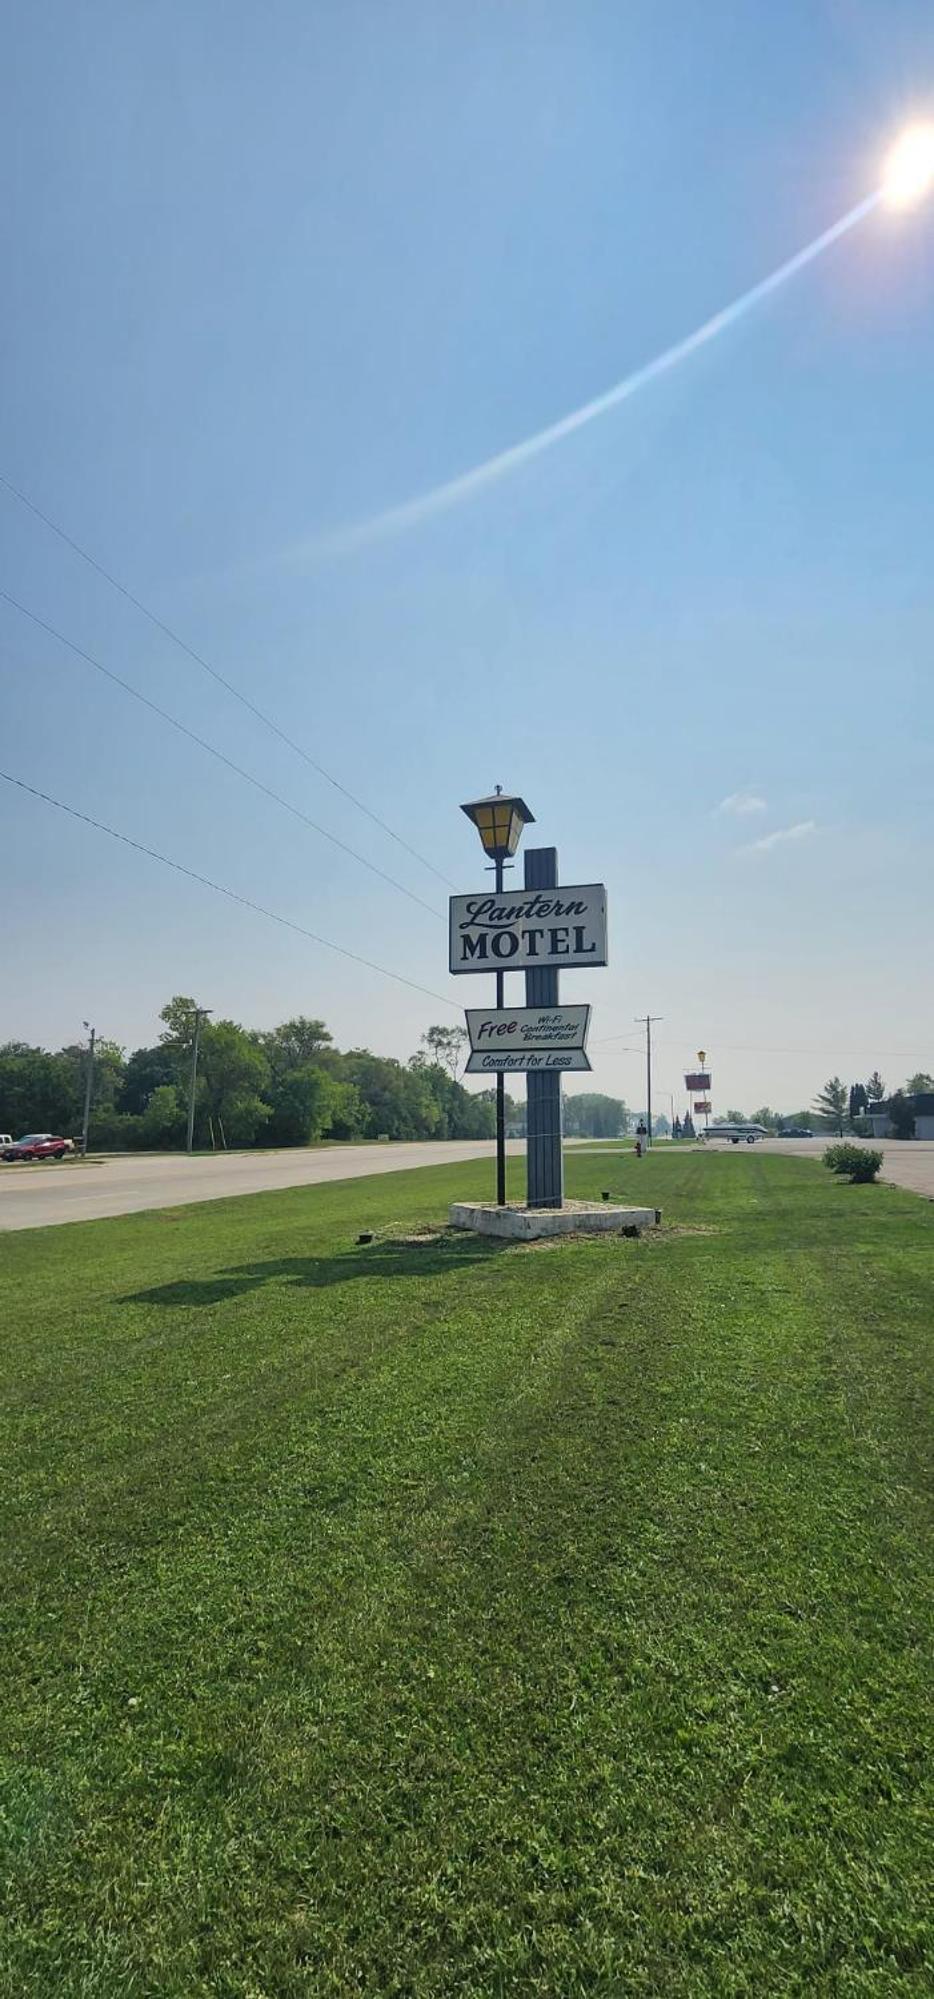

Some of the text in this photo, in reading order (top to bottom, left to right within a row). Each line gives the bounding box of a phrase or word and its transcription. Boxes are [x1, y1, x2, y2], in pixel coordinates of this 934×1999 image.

[459, 894, 588, 929] Lantern
[460, 926, 596, 961] MOTEL
[477, 1021, 518, 1040] Free
[521, 1023, 579, 1033] Continental
[523, 1031, 577, 1041] Breakfast
[482, 1054, 572, 1067] Comfort for Less
